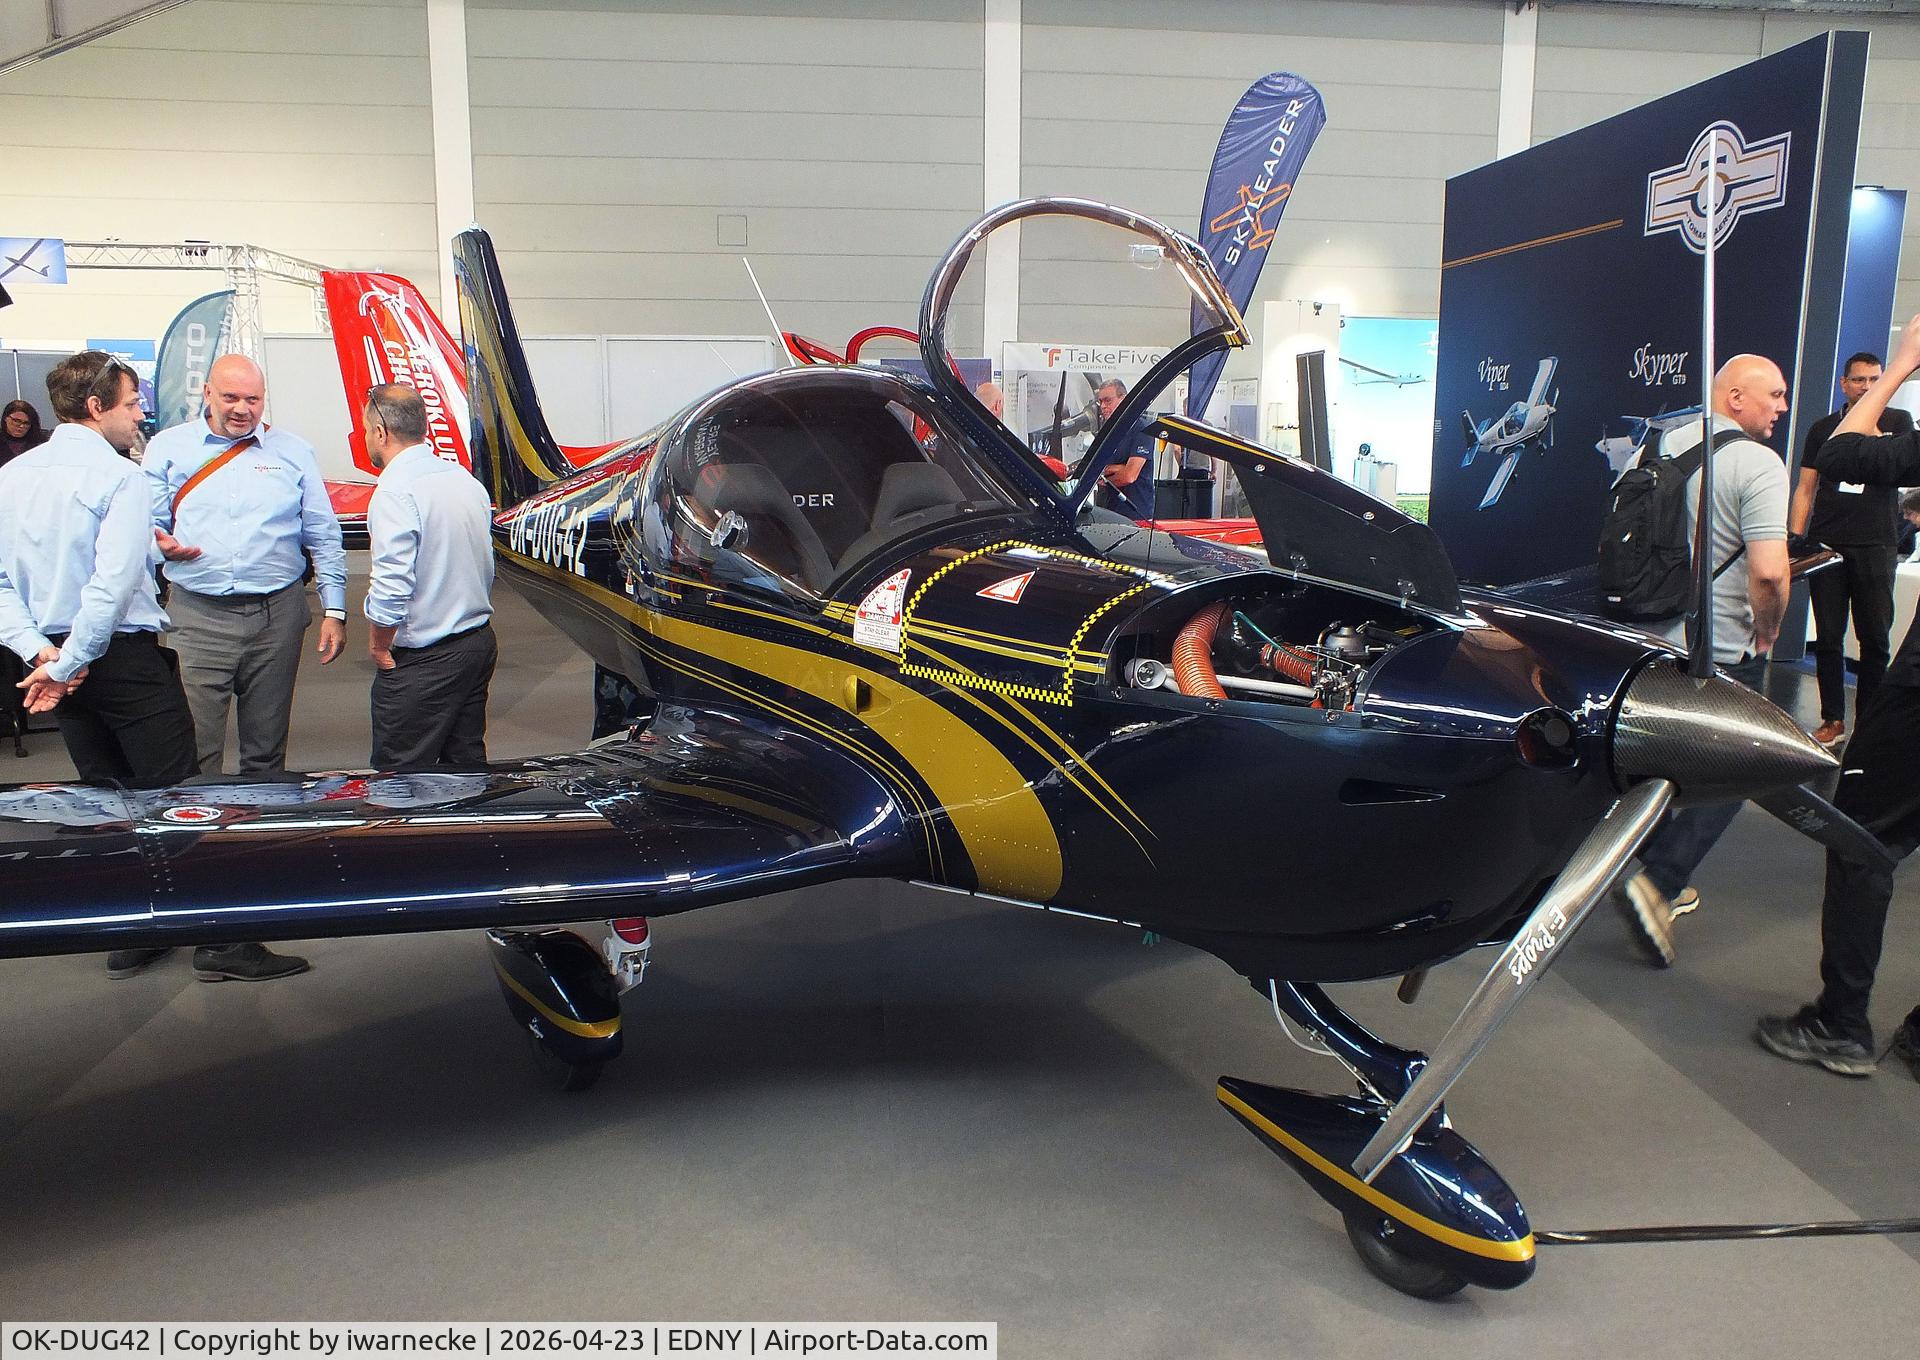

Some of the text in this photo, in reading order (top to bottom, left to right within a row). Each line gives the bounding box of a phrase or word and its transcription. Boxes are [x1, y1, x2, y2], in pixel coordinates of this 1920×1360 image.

[1225, 98, 1304, 266] SKYLEADER
[1065, 348, 1162, 365] TakeFive
[1478, 356, 1510, 391] Viper
[1629, 342, 1688, 386] Skyper
[510, 500, 587, 578] OK-DUG42
[866, 612, 892, 624] DANGER
[1508, 904, 1567, 985] E-Props
